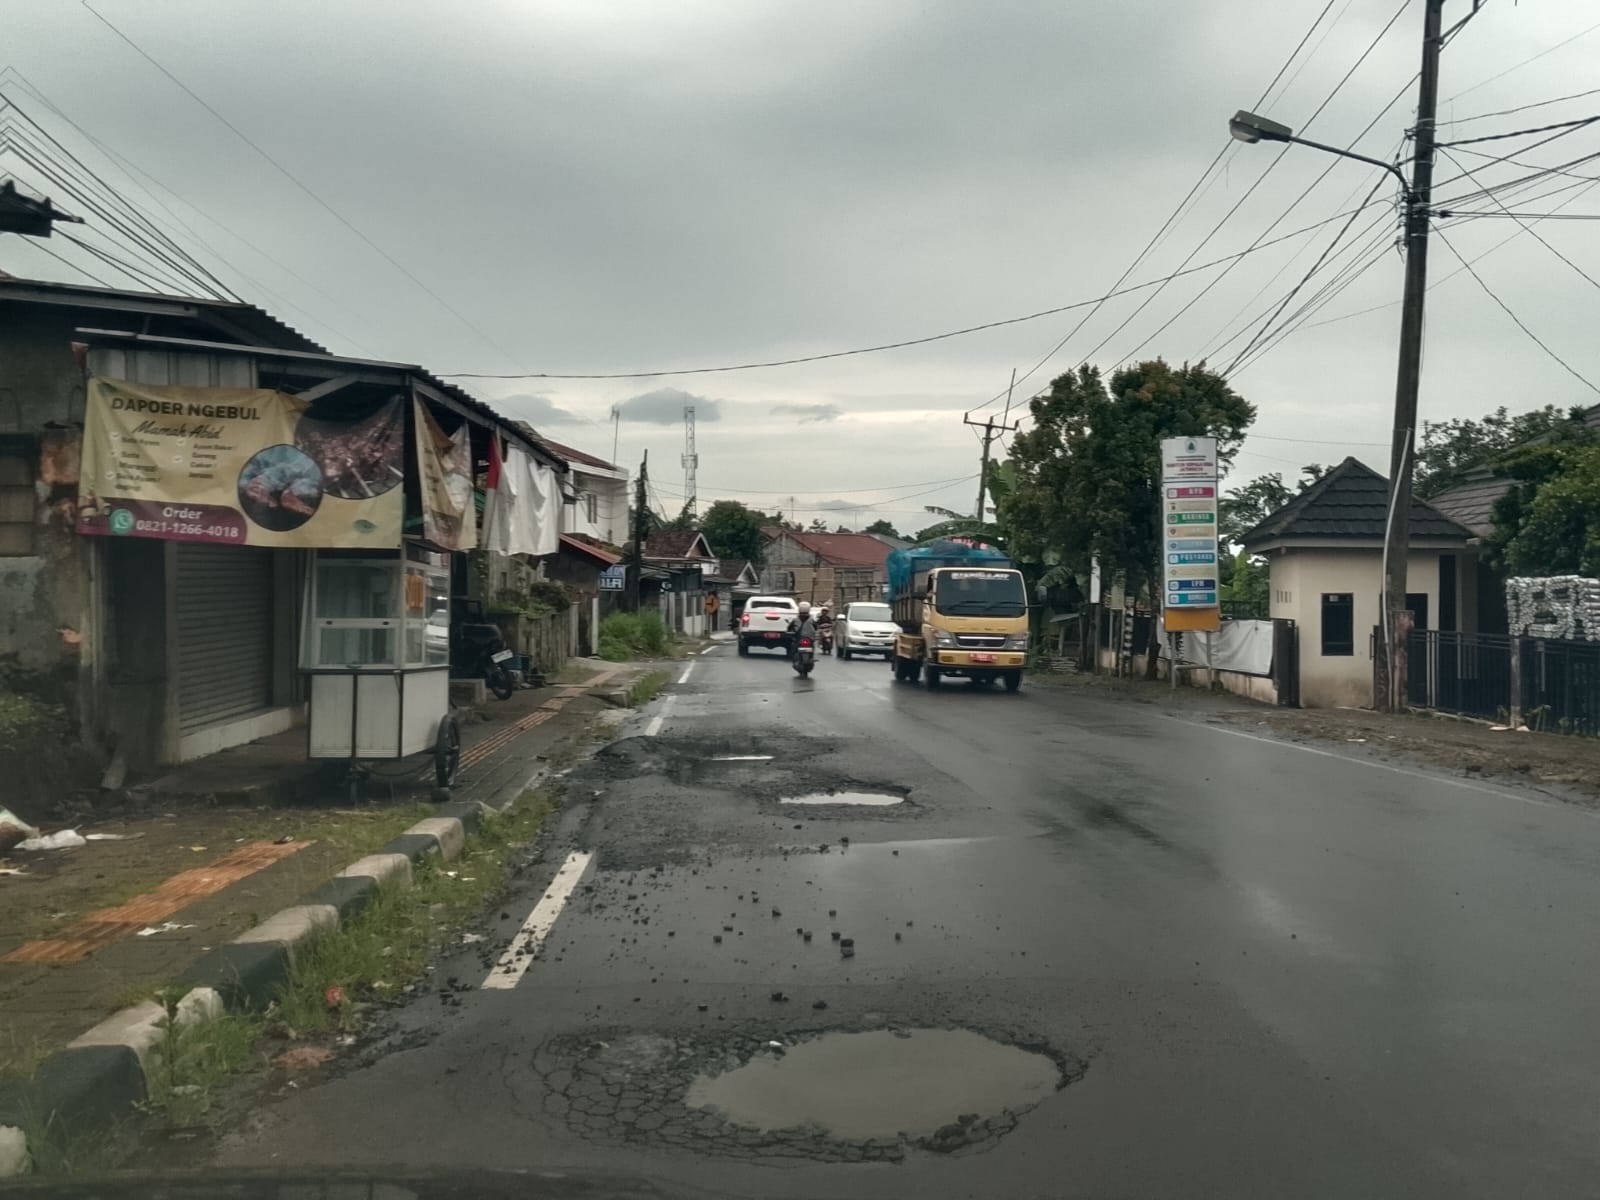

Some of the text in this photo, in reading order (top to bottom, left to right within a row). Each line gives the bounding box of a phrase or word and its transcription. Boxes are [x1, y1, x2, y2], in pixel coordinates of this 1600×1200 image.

[111, 398, 262, 420] DAPOER NGEBUL
[162, 507, 203, 520] Order
[136, 520, 239, 537] 0821-1266-4018
